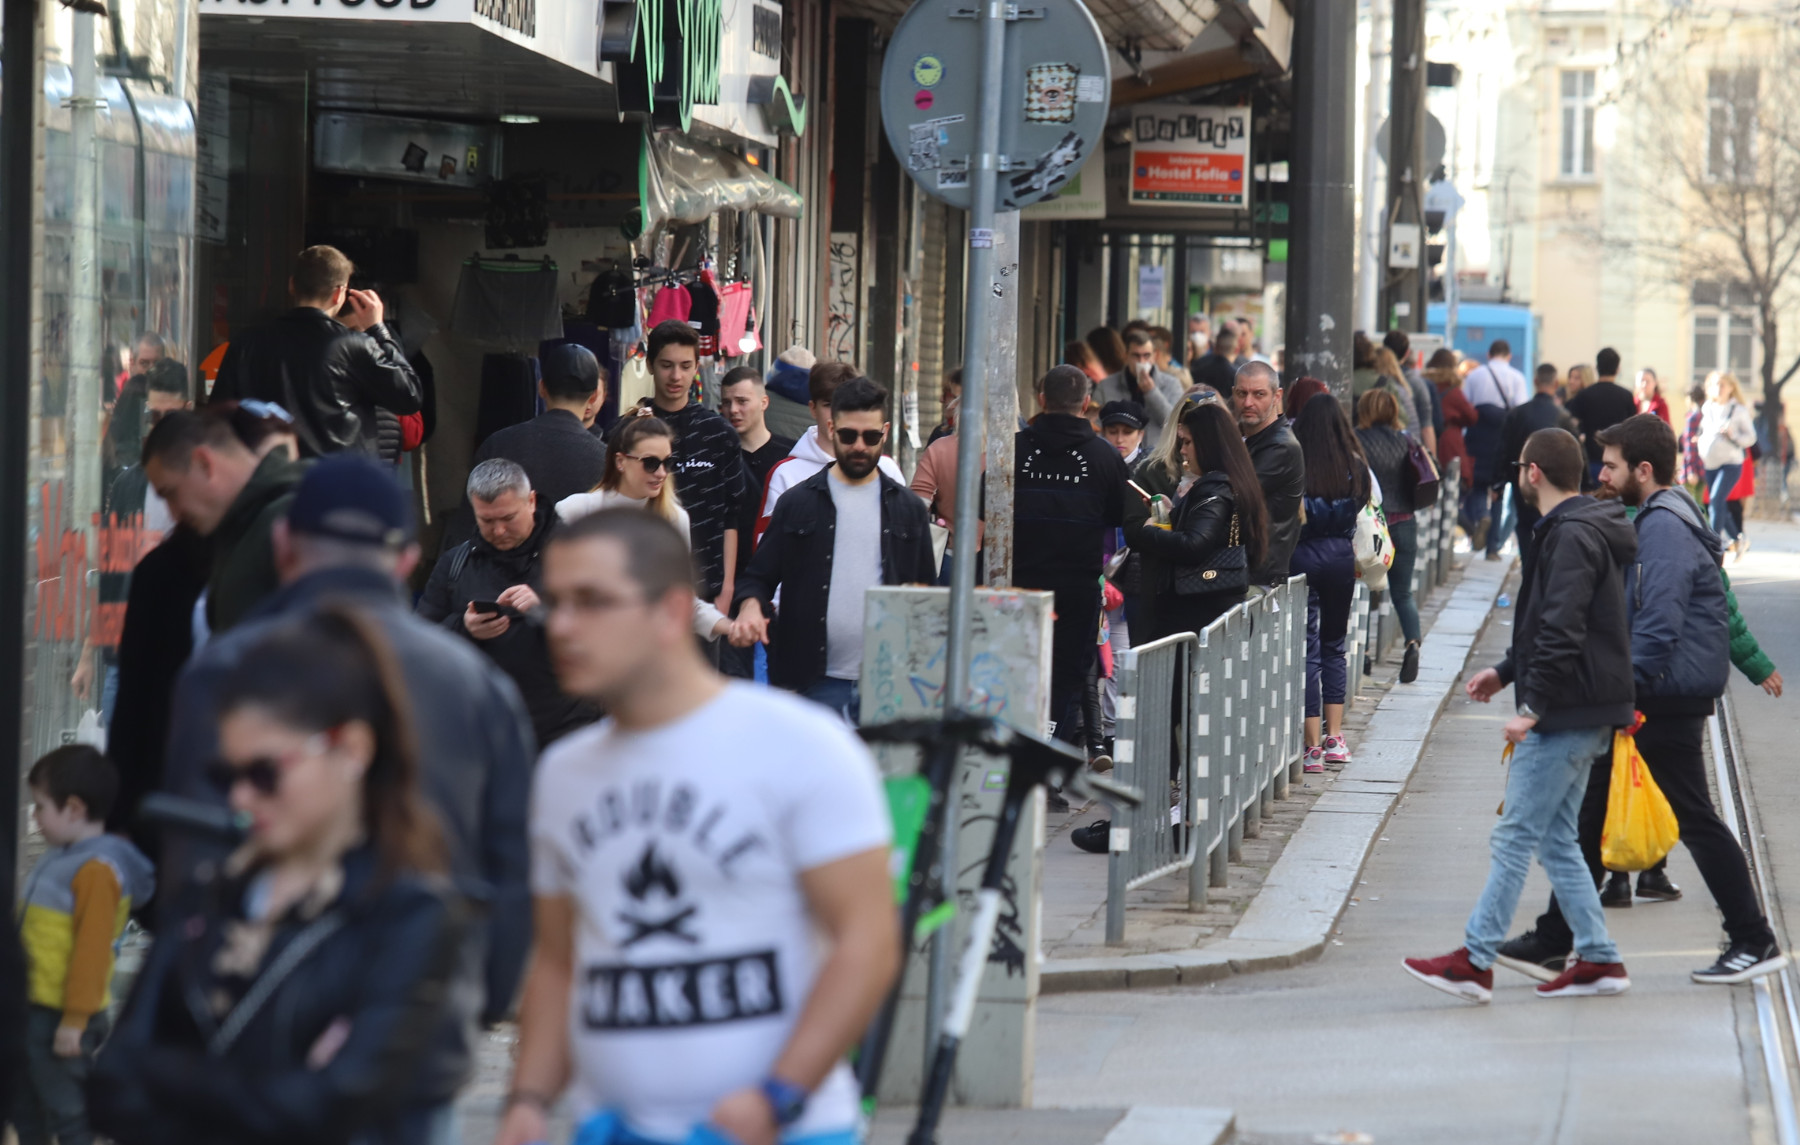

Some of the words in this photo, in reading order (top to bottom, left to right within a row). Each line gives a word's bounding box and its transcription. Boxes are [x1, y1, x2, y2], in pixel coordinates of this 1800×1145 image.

[1148, 166, 1192, 180] Hostel
[1195, 167, 1228, 182] Sofia
[1030, 472, 1080, 484] living
